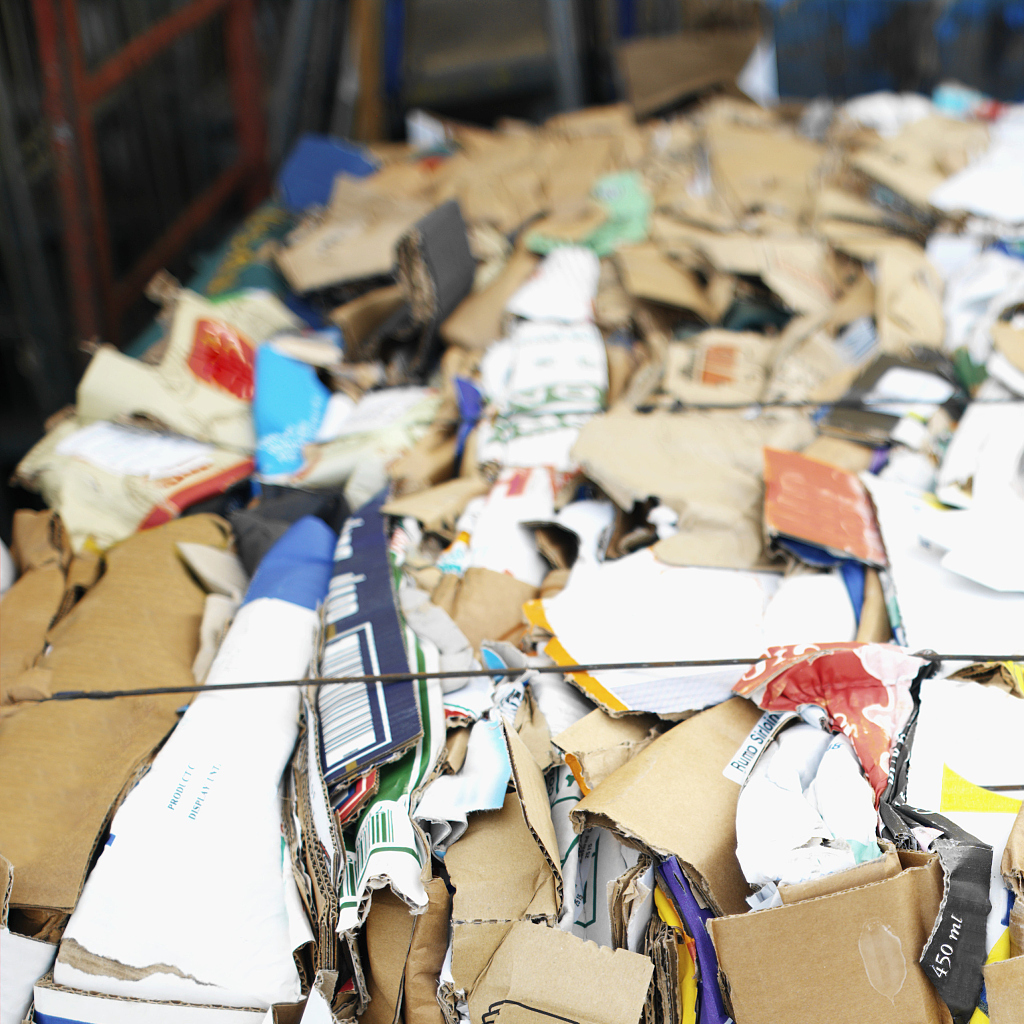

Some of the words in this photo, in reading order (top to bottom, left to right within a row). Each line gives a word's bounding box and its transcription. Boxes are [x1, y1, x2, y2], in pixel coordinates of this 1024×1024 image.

[750, 713, 780, 745] Sirloin
[929, 943, 954, 978] 450
[949, 913, 963, 941] ml
